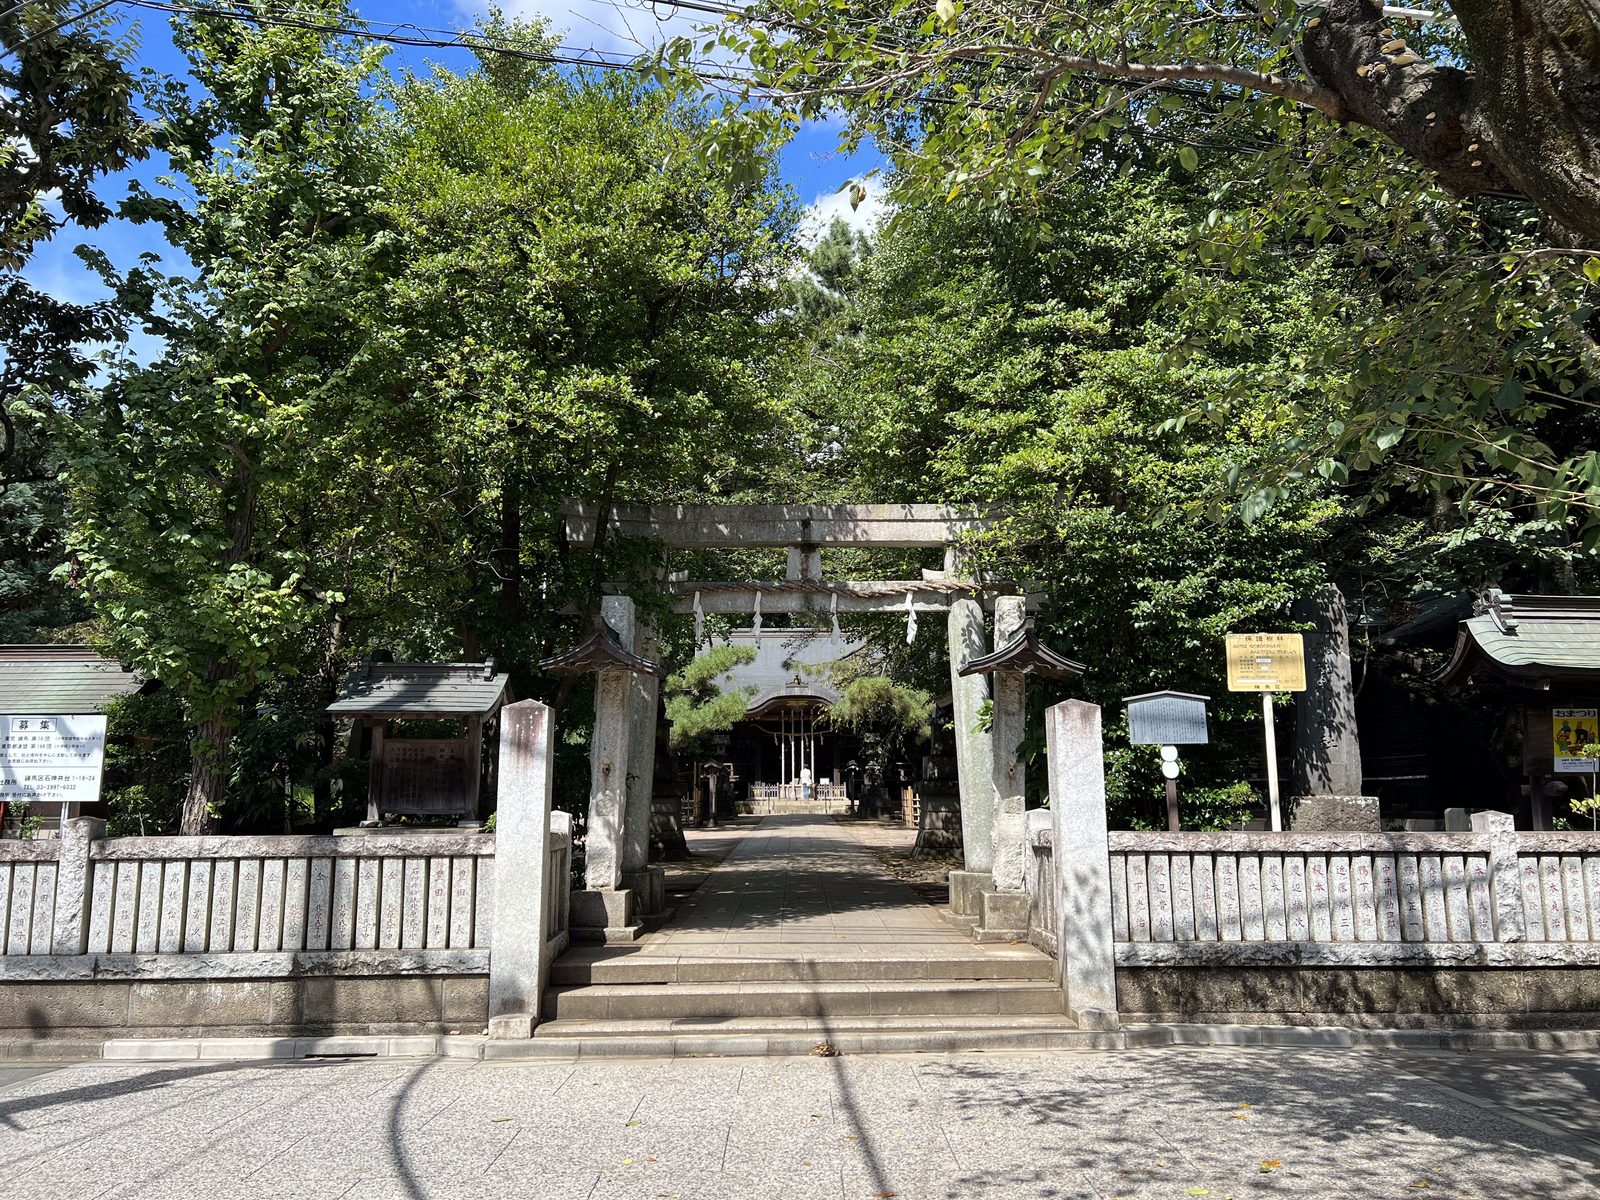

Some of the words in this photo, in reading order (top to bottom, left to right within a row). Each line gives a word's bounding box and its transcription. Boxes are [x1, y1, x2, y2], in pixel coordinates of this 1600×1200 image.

[1554, 709, 1596, 717] おまつり
[19, 720, 50, 730] 募集
